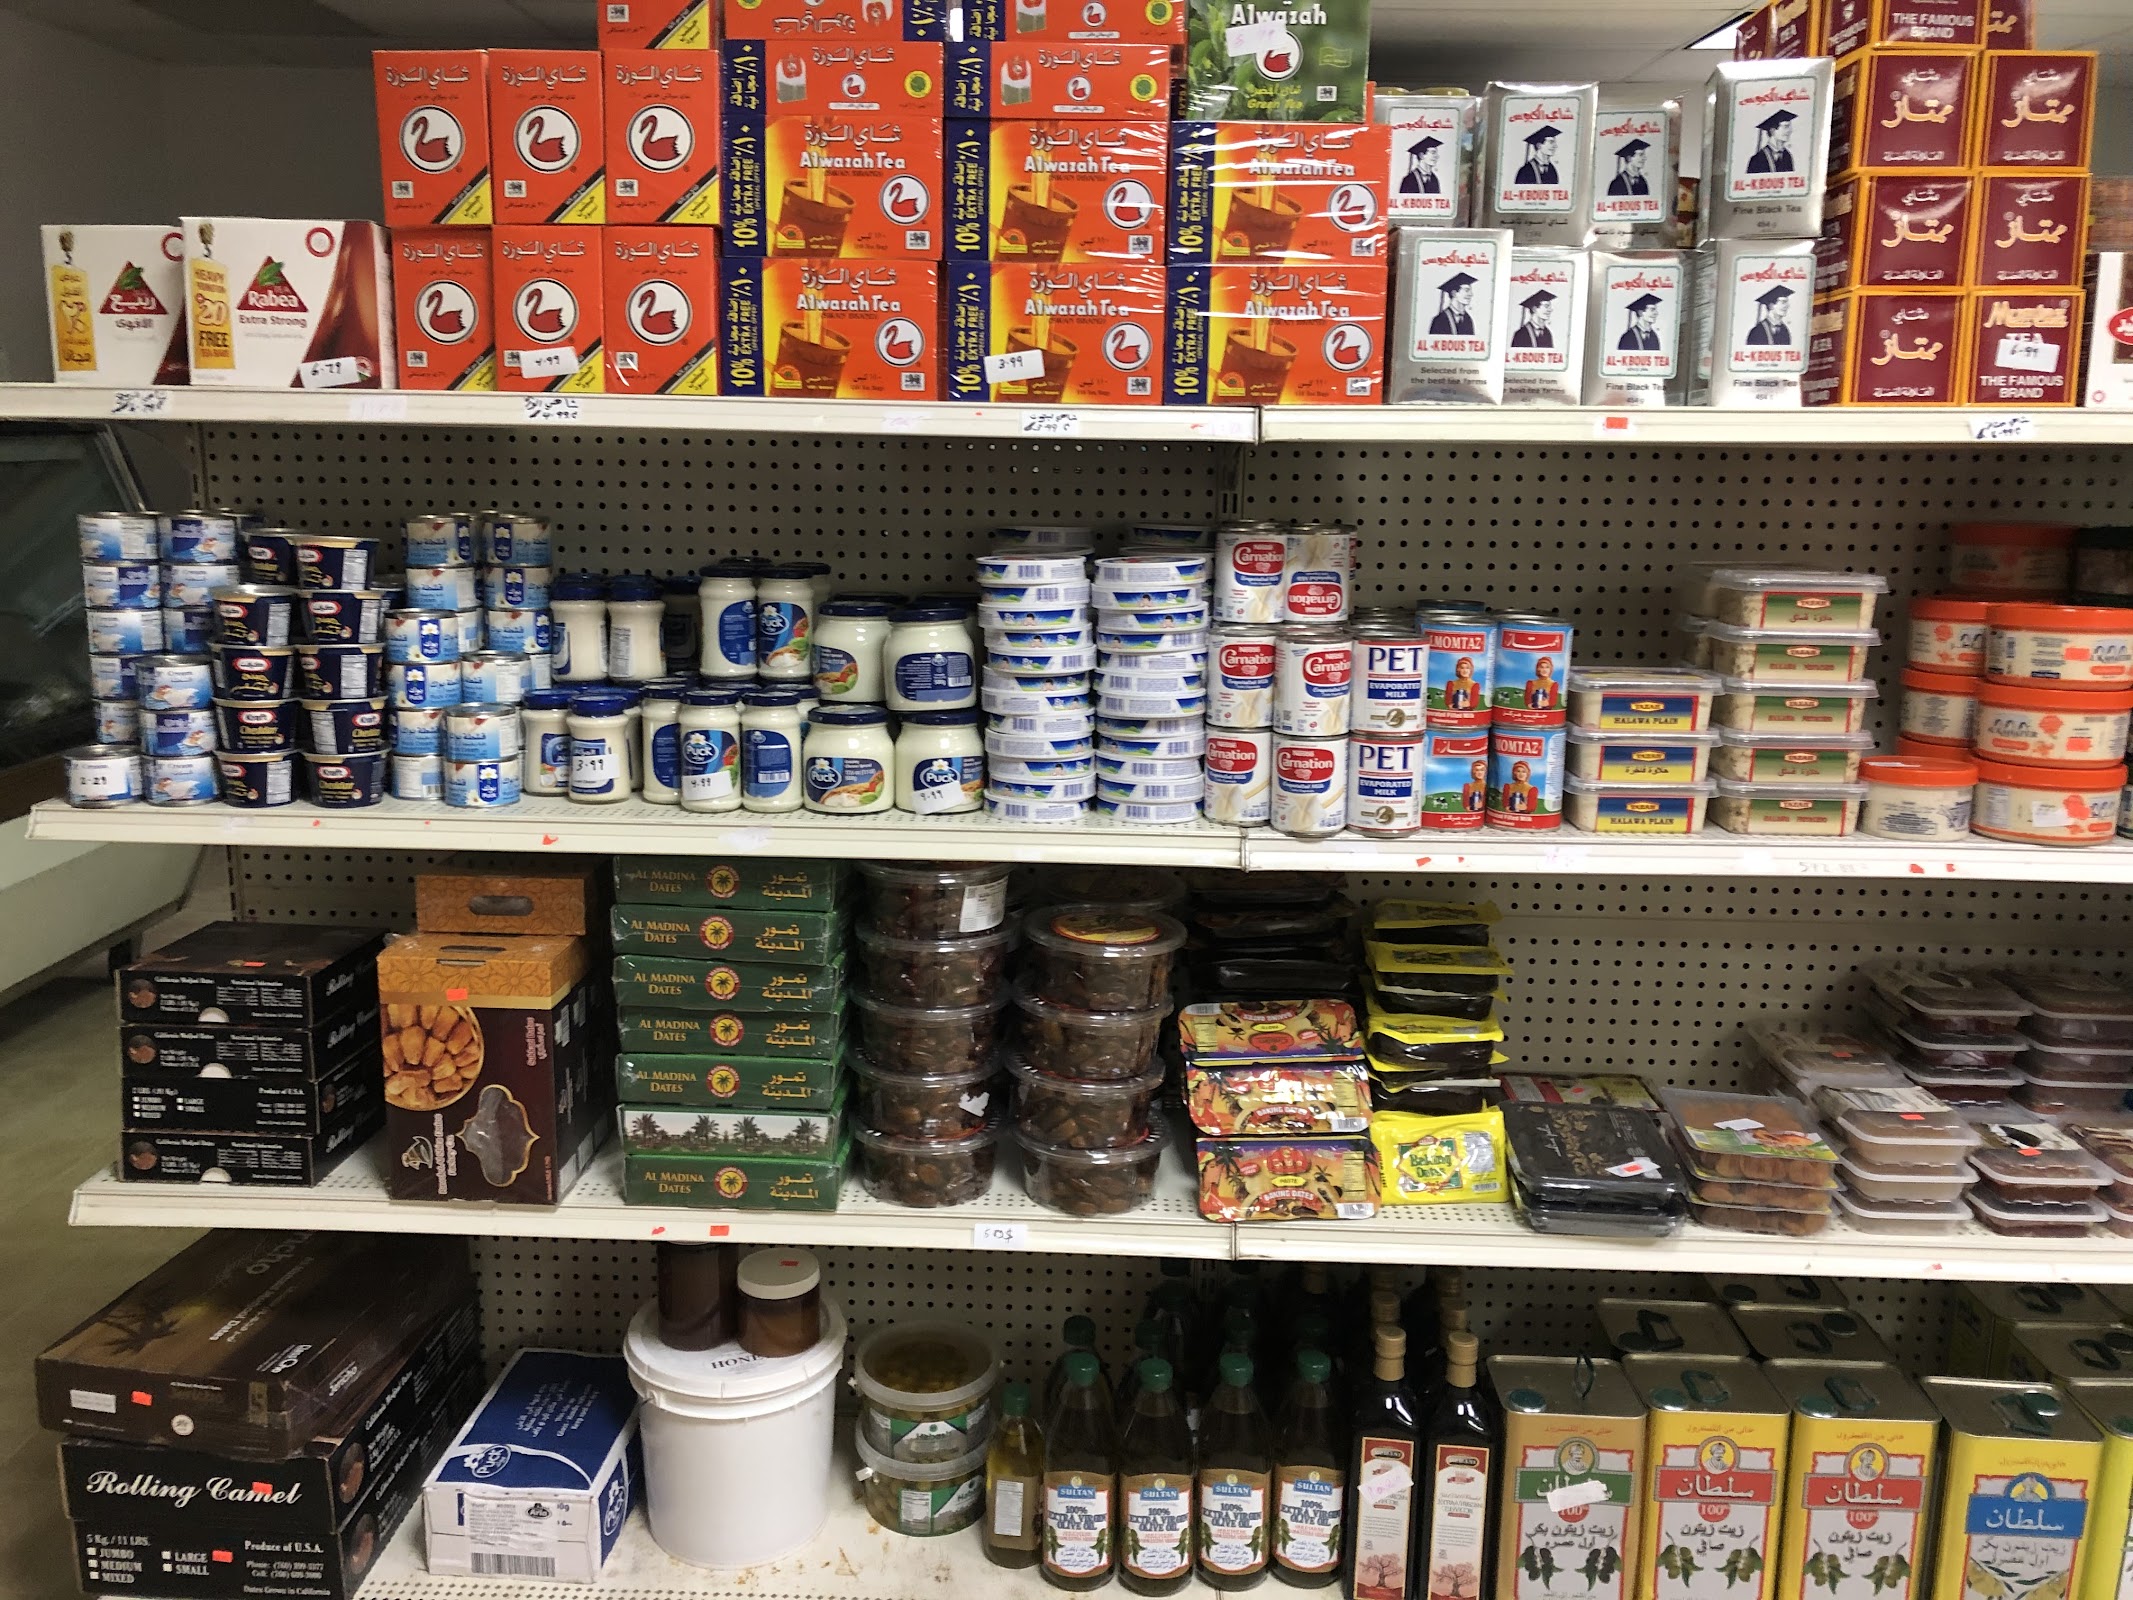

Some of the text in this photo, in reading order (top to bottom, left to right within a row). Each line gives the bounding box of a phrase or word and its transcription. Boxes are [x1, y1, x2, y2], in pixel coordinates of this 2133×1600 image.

[1231, 4, 1327, 26] Alwazah
[811, 46, 896, 71] شاي الوزة
[1038, 49, 1122, 73] شاي الوزة
[385, 63, 470, 89] شاي الوزة
[501, 63, 588, 89] شاي الوزة
[615, 63, 704, 89] شاي الوزة
[853, 123, 902, 150] شاي
[799, 152, 907, 170] Alwazah Tea
[1024, 155, 1131, 174] Alwazah Tea
[1787, 177, 1806, 189] TEA
[1552, 189, 1569, 201] TEA
[1643, 200, 1660, 212] TEA
[732, 217, 759, 249] 10%
[955, 222, 981, 253] 10%
[247, 289, 300, 309] Rabea
[796, 293, 902, 313] Alwazah Tea
[1024, 299, 1130, 317] Alwazah Tea
[238, 314, 307, 329] Extra Strong
[1468, 340, 1486, 352] TEA
[1654, 355, 1670, 367] TEA
[1786, 350, 1802, 362] TEA
[730, 357, 757, 388] 10%
[1173, 366, 1200, 396] 10%
[1605, 382, 1650, 392] Fine Black
[1733, 379, 1753, 388] Fine
[1980, 375, 2064, 387] THE FAMOUS
[1998, 387, 2044, 399] BRAND
[1234, 546, 1285, 566] Carnation
[1288, 591, 1342, 610] Carnation
[1221, 649, 1274, 668] Carnation
[1368, 647, 1423, 672] PET
[1369, 681, 1421, 690] EVAPORATED
[1384, 690, 1408, 699] MILK
[1613, 716, 1679, 726] HALAWA PLAIN
[687, 745, 714, 758] Puck
[1207, 741, 1256, 761] Carnation
[1359, 745, 1414, 771] PET
[1277, 751, 1334, 769] Carnation
[811, 770, 837, 784] Puck
[926, 770, 956, 784] Puck
[1358, 780, 1412, 788] EVAPORATED
[1374, 788, 1398, 796] MILK
[1609, 817, 1675, 826] HALAWA PLAIN
[630, 919, 691, 933] AL MADINA
[762, 923, 800, 938] تمور
[643, 932, 678, 944] DATES
[754, 937, 805, 954] المدينة
[633, 972, 696, 985] AL MADINA
[769, 972, 808, 987] تمور
[648, 984, 682, 996] DATES
[761, 987, 813, 1002] المدينة
[639, 1019, 701, 1031] AL MADINA
[772, 1019, 811, 1034] تمور
[652, 1030, 687, 1042] DATES
[765, 1033, 816, 1049] المدينة
[636, 1071, 697, 1082] AL MADINA
[649, 1081, 684, 1093] DATES
[761, 1085, 812, 1101] المدينة
[643, 1171, 705, 1183] AL MADINA
[775, 1172, 814, 1187] تمور
[658, 1182, 692, 1194] DATES
[769, 1185, 819, 1202] المدينة
[1263, 1188, 1315, 1202] BAKING DATES
[86, 1470, 303, 1509] Rolling Camel
[1060, 1489, 1094, 1497] SULTAN
[1215, 1485, 1250, 1495] SULTAN
[1296, 1481, 1331, 1492] SULTAN
[1675, 1474, 1756, 1500] سلطان
[1143, 1490, 1177, 1498] SULTAN
[1823, 1482, 1904, 1506] سلطان
[1065, 1505, 1088, 1514] 100%
[1148, 1507, 1171, 1516] 100%
[1220, 1502, 1243, 1512] 100%
[1300, 1499, 1323, 1510] 100%
[1057, 1520, 1098, 1531] OLIVE OIL
[1138, 1522, 1180, 1532] OLIVE OIL
[1211, 1518, 1252, 1528] OLIVE OIL
[1289, 1514, 1332, 1526] OLIVE OIL
[1985, 1508, 2065, 1533] سلطان
[1526, 1522, 1615, 1537] زيت زيتون بكر
[1679, 1523, 1745, 1537] زيت زيتون
[1827, 1530, 1893, 1545] زيت زيتون
[244, 1540, 324, 1554] Produce of U.S.A.
[174, 1552, 209, 1563] LARGE
[175, 1564, 210, 1576] SMALL
[102, 1573, 135, 1584] MIXED
